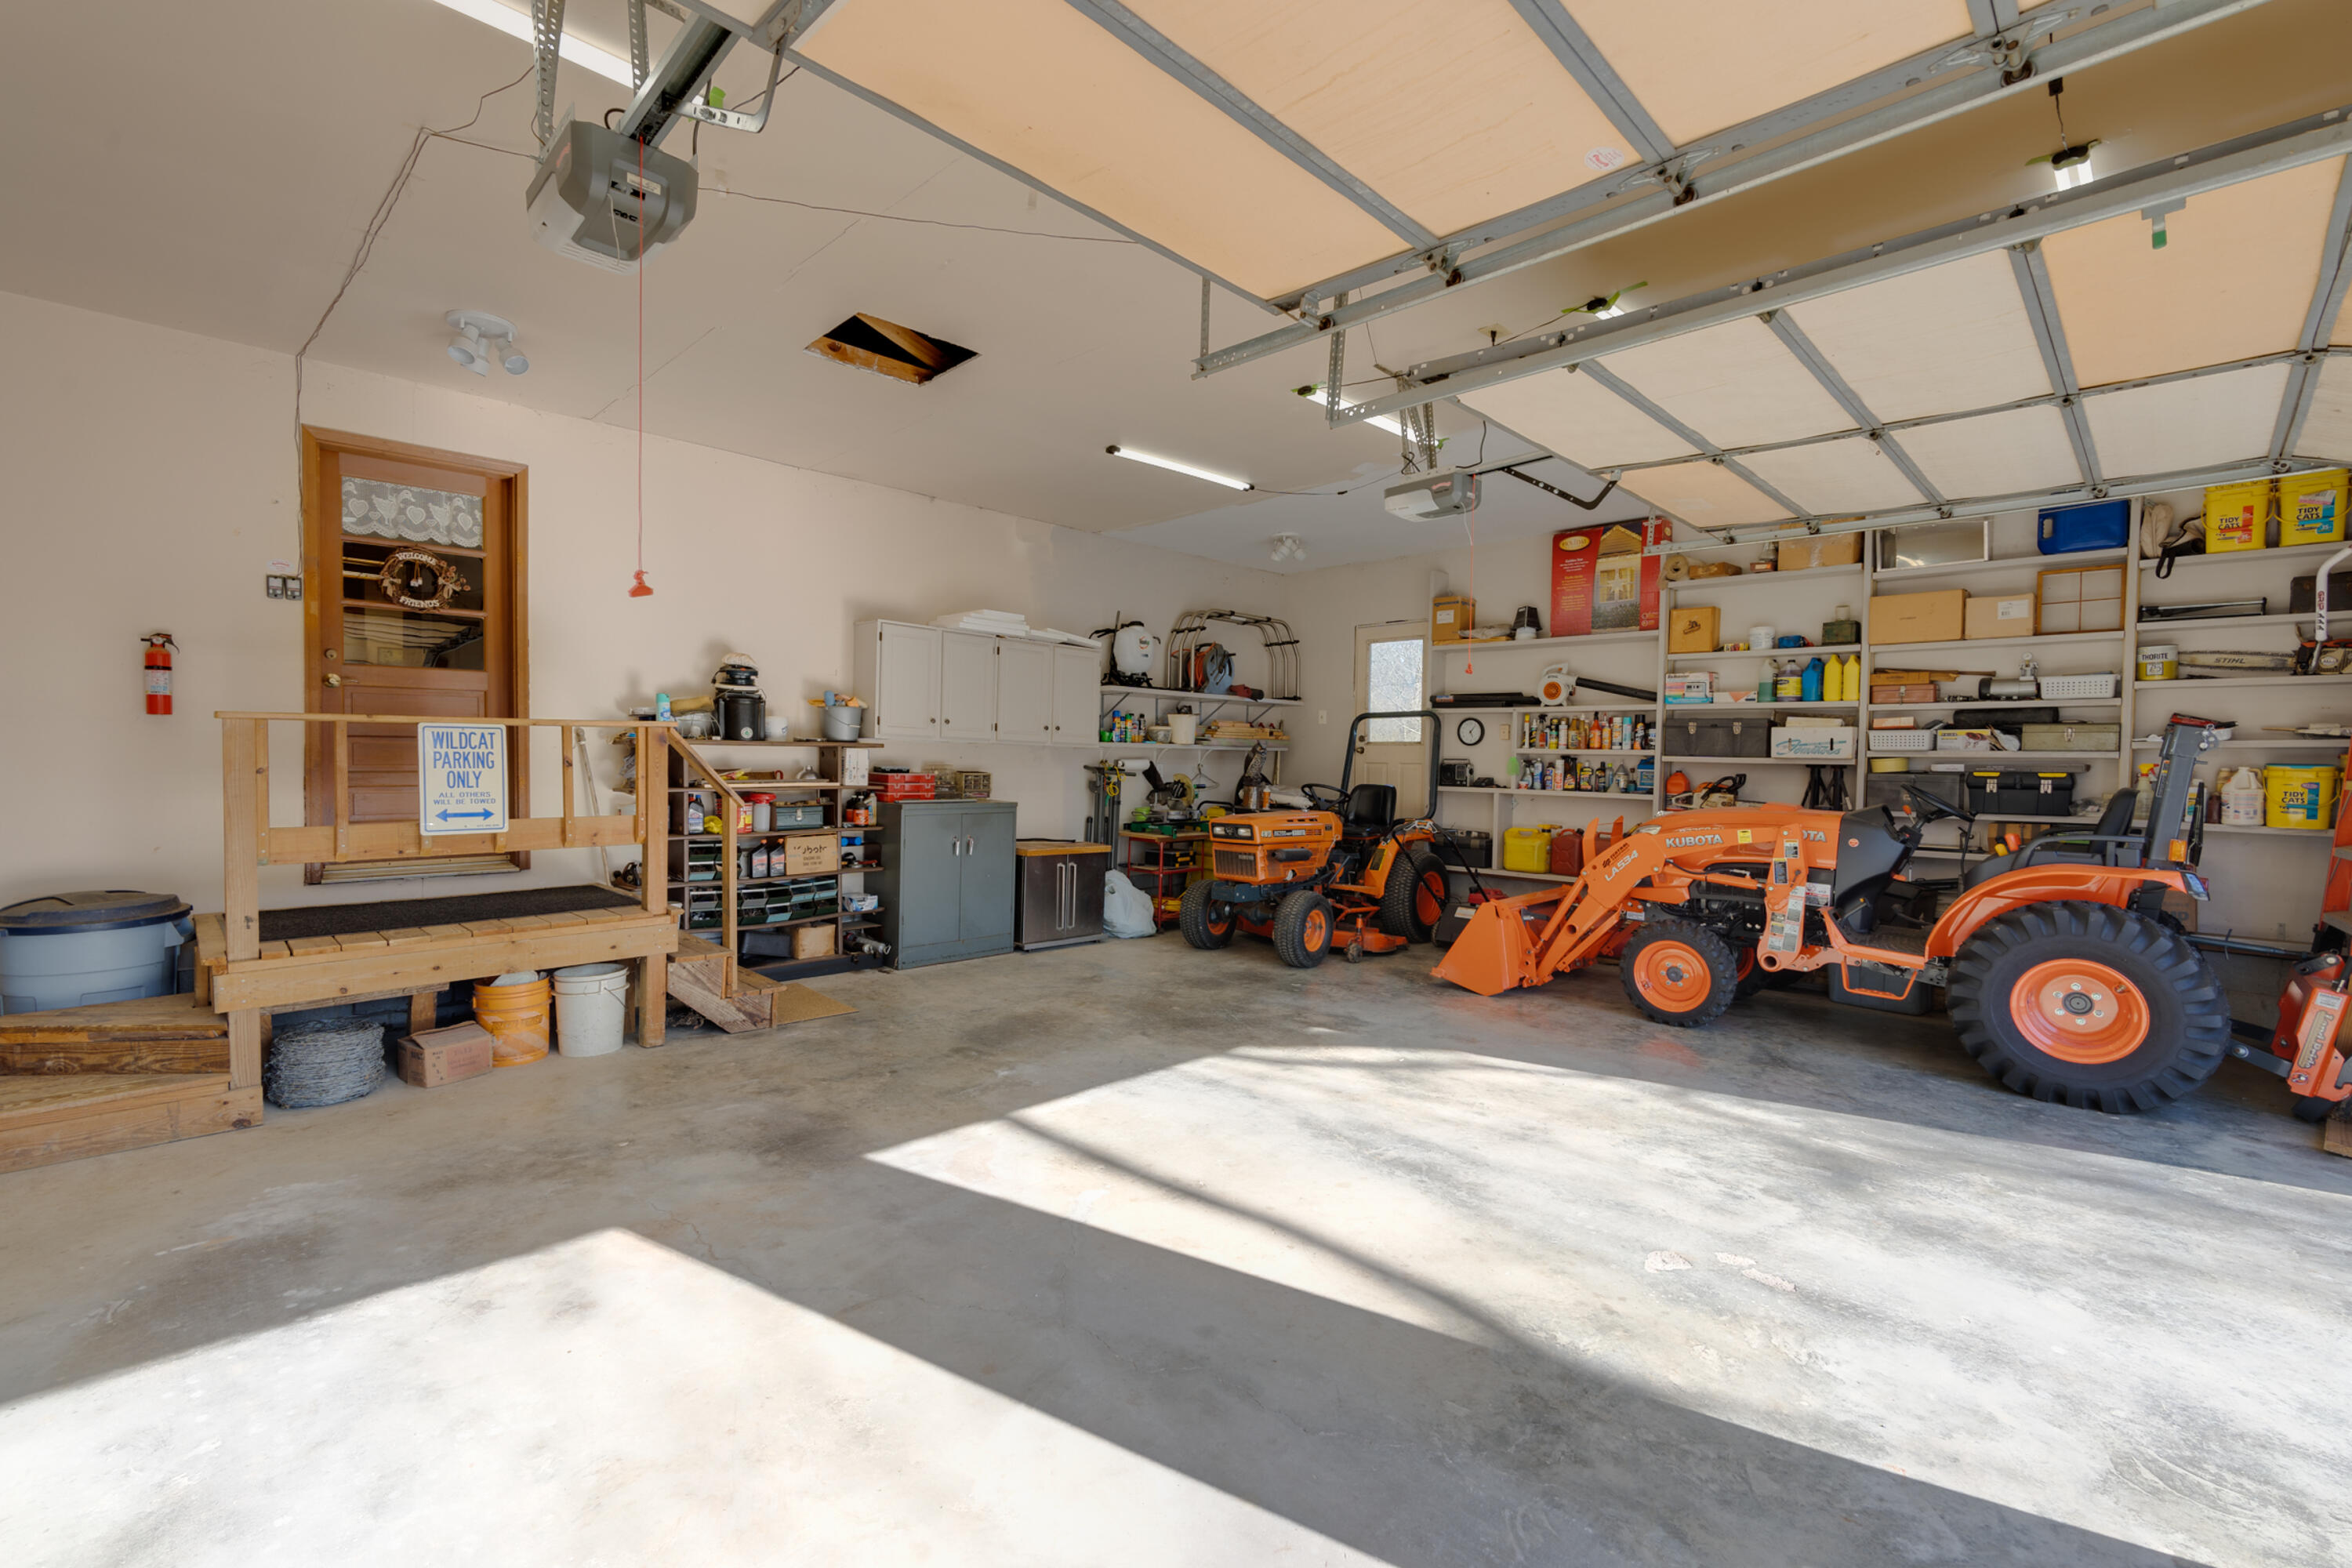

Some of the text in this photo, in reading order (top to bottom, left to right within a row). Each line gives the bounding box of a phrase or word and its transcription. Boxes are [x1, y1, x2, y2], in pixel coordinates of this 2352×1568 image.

[399, 596, 440, 608] FRIENDS
[431, 731, 496, 750] WILDCAT
[433, 751, 495, 769] PARKING
[446, 771, 482, 789] ONLY
[1665, 834, 1723, 848] KUBOTA
[1604, 849, 1639, 882] LA534
[2317, 1014, 2335, 1041] Land
[2304, 1041, 2323, 1069] Pride
